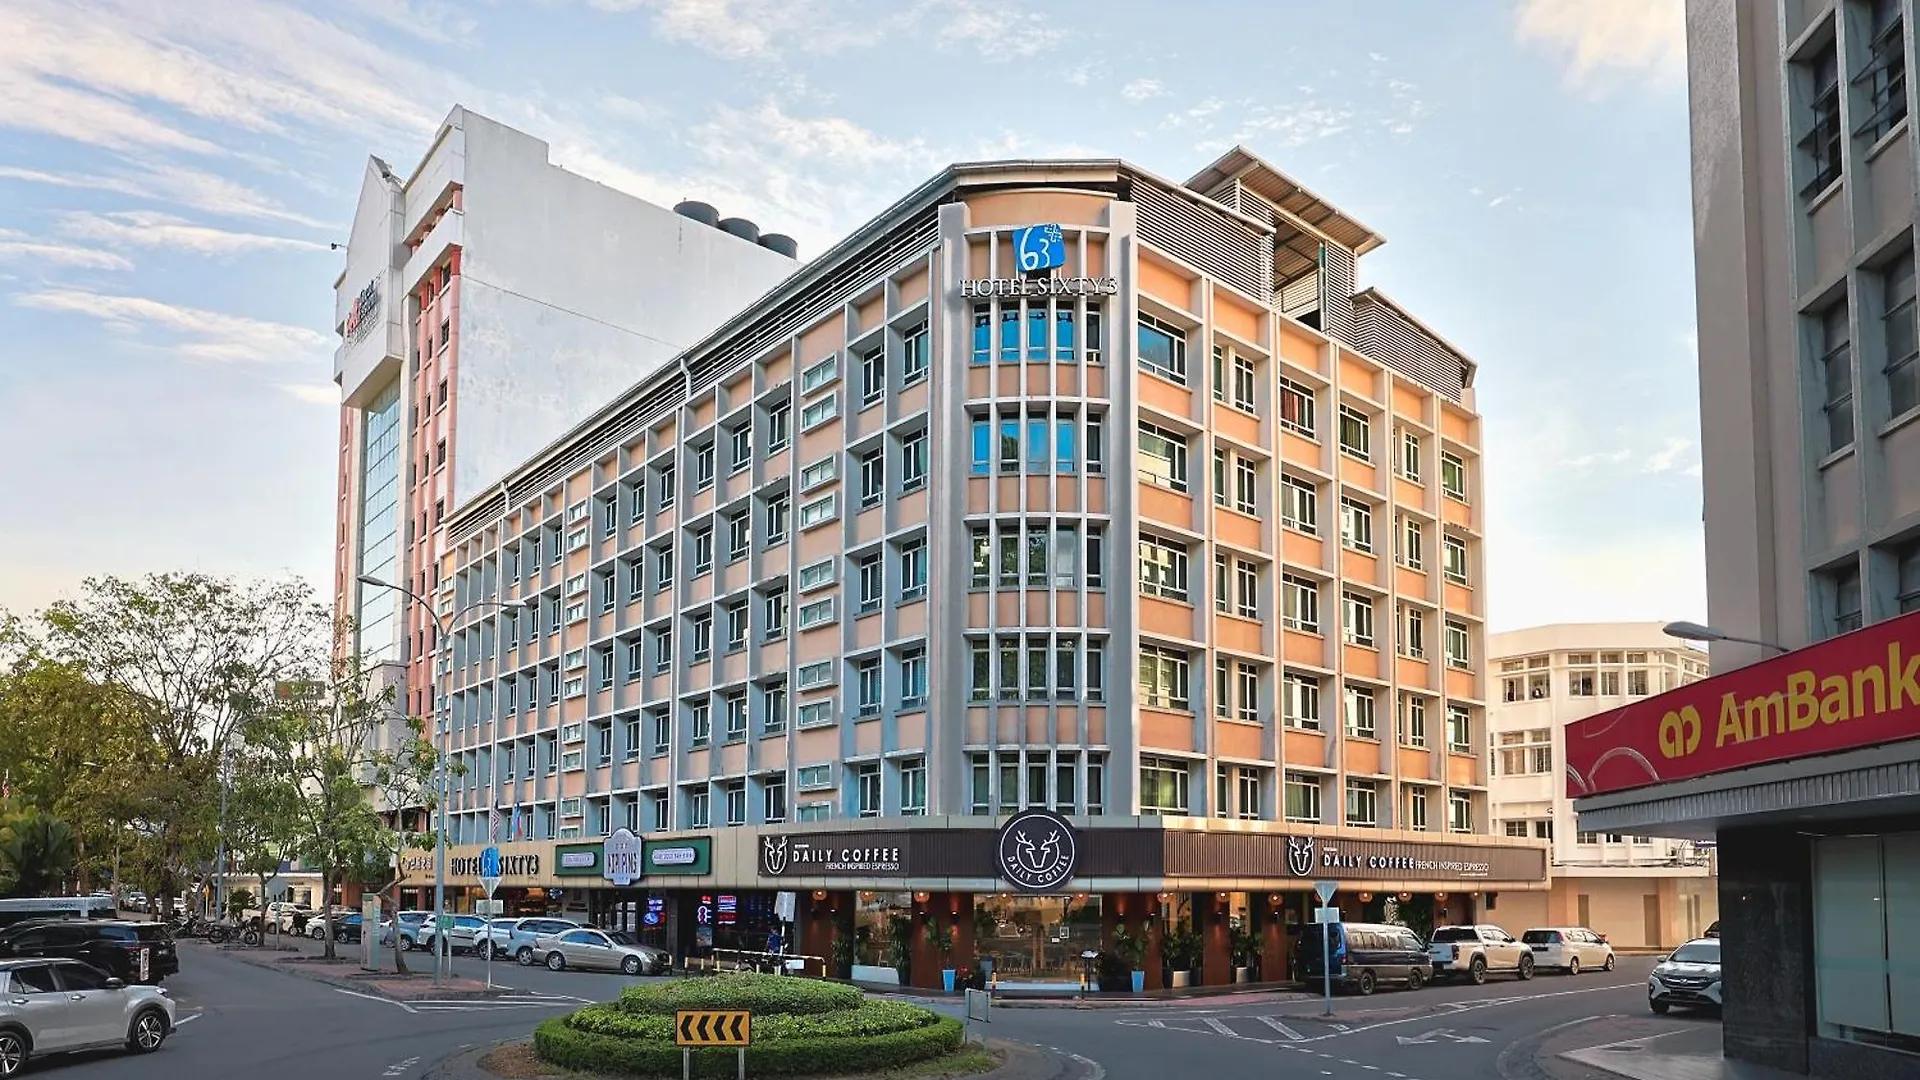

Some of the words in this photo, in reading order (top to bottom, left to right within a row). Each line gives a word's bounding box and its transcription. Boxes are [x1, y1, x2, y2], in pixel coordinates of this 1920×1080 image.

[1020, 227, 1050, 271] 63
[960, 277, 1032, 297] HOTEL
[1715, 641, 1920, 748] AmBank
[793, 849, 833, 862] DAILY
[841, 848, 899, 862] COFFEE
[1324, 854, 1362, 868] DAILY
[1369, 855, 1414, 869] COFFEE
[1007, 856, 1032, 881] DAILY
[1038, 855, 1069, 883] COFFEE
